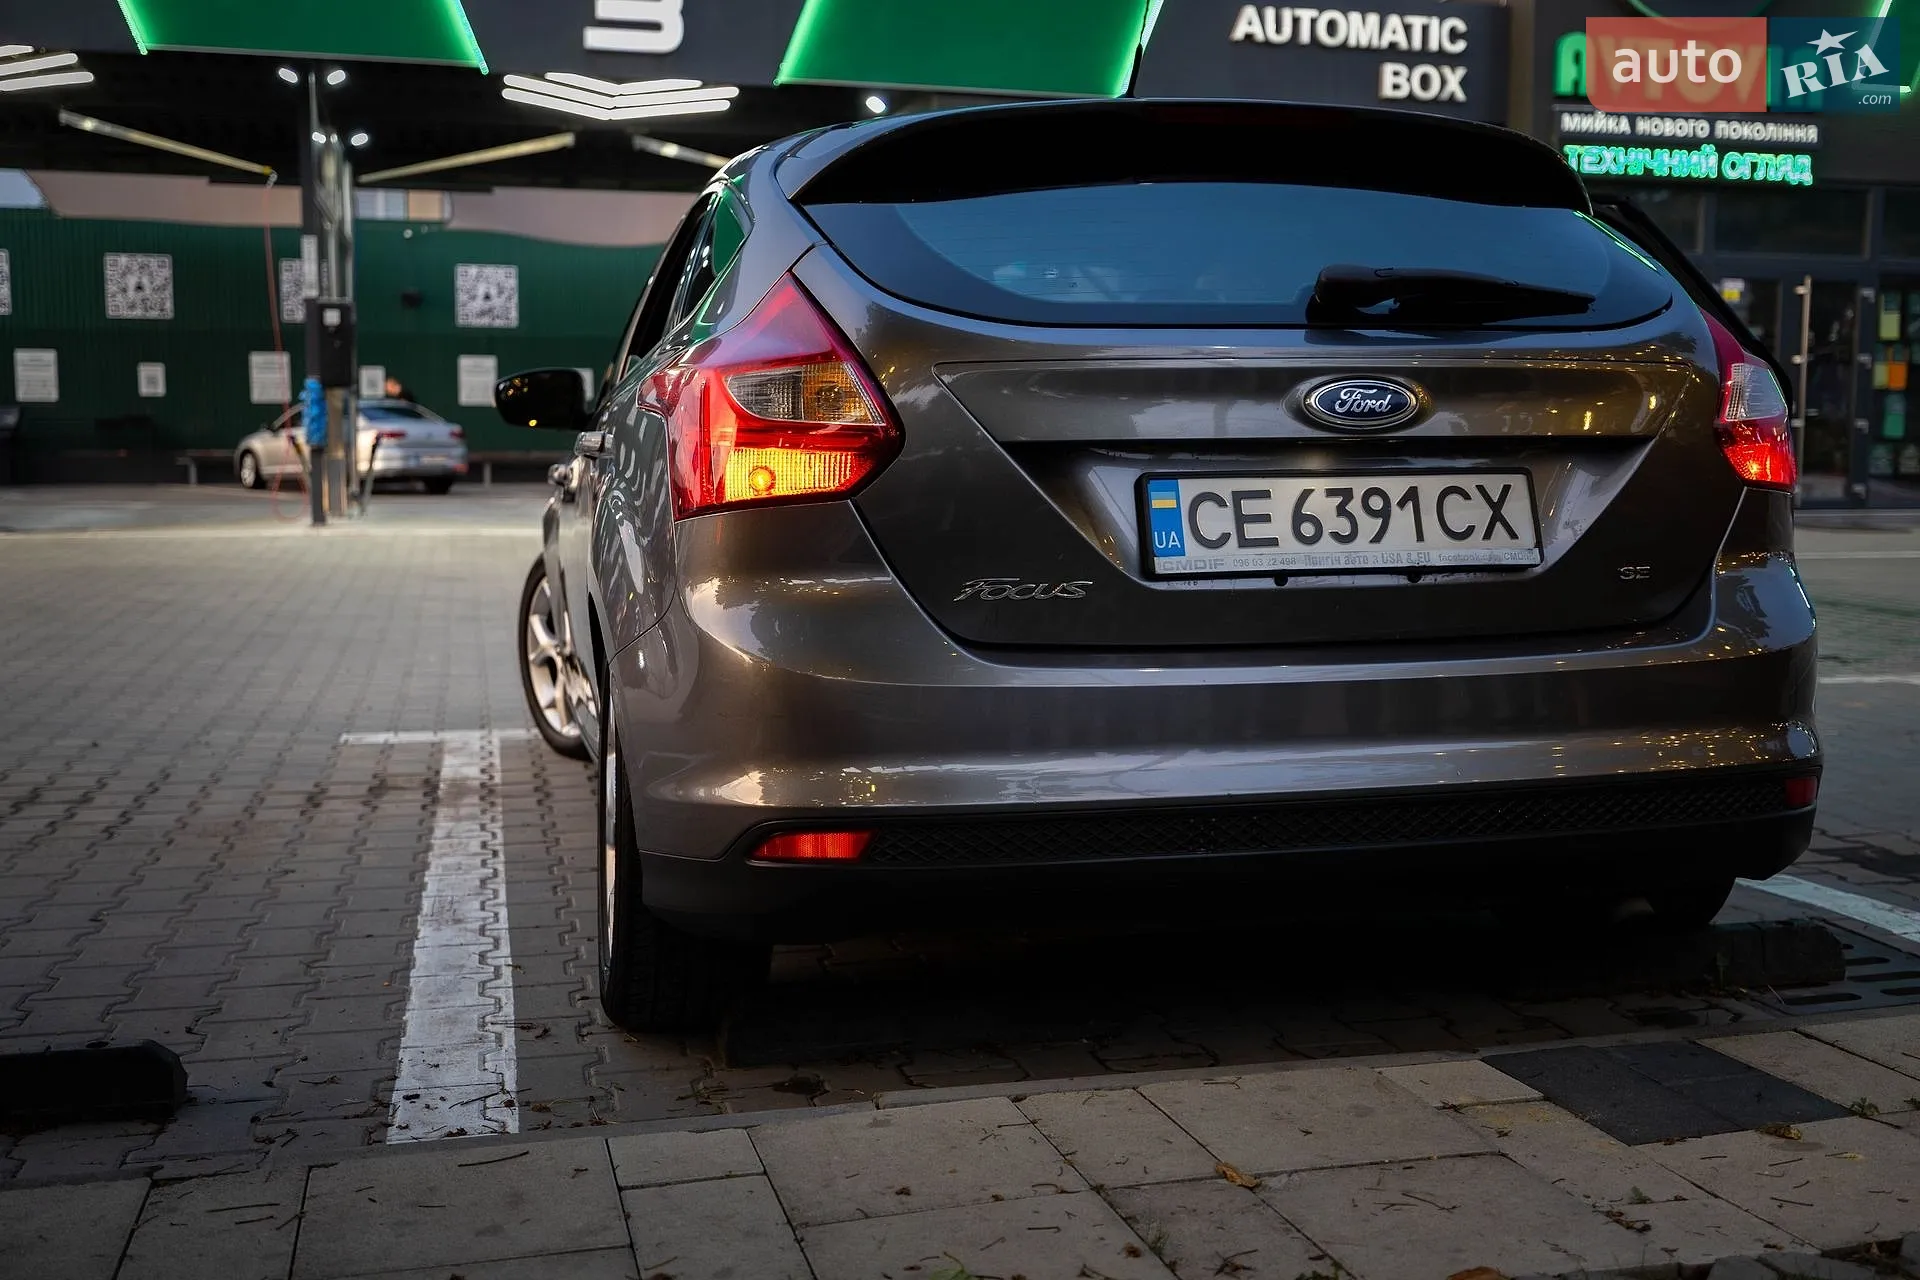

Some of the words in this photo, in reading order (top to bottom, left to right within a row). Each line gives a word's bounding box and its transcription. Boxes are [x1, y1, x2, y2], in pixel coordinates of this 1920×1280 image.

[1229, 4, 1468, 54] AUTOMATIC
[1379, 61, 1468, 102] BOX
[1560, 111, 1631, 135] МИЙКА
[1635, 116, 1710, 139] НОВОГО
[1714, 120, 1819, 144] ПОКОЛІННЯ
[1334, 387, 1392, 413] Ford
[1187, 489, 1279, 549] CE
[1290, 485, 1425, 545] 6391
[1435, 483, 1520, 541] CX
[1154, 530, 1182, 550] UA
[1279, 556, 1297, 566] 498
[1381, 551, 1404, 564] USA
[1416, 551, 1432, 563] EU
[1619, 566, 1651, 580] SE
[952, 577, 1094, 602] Focus
